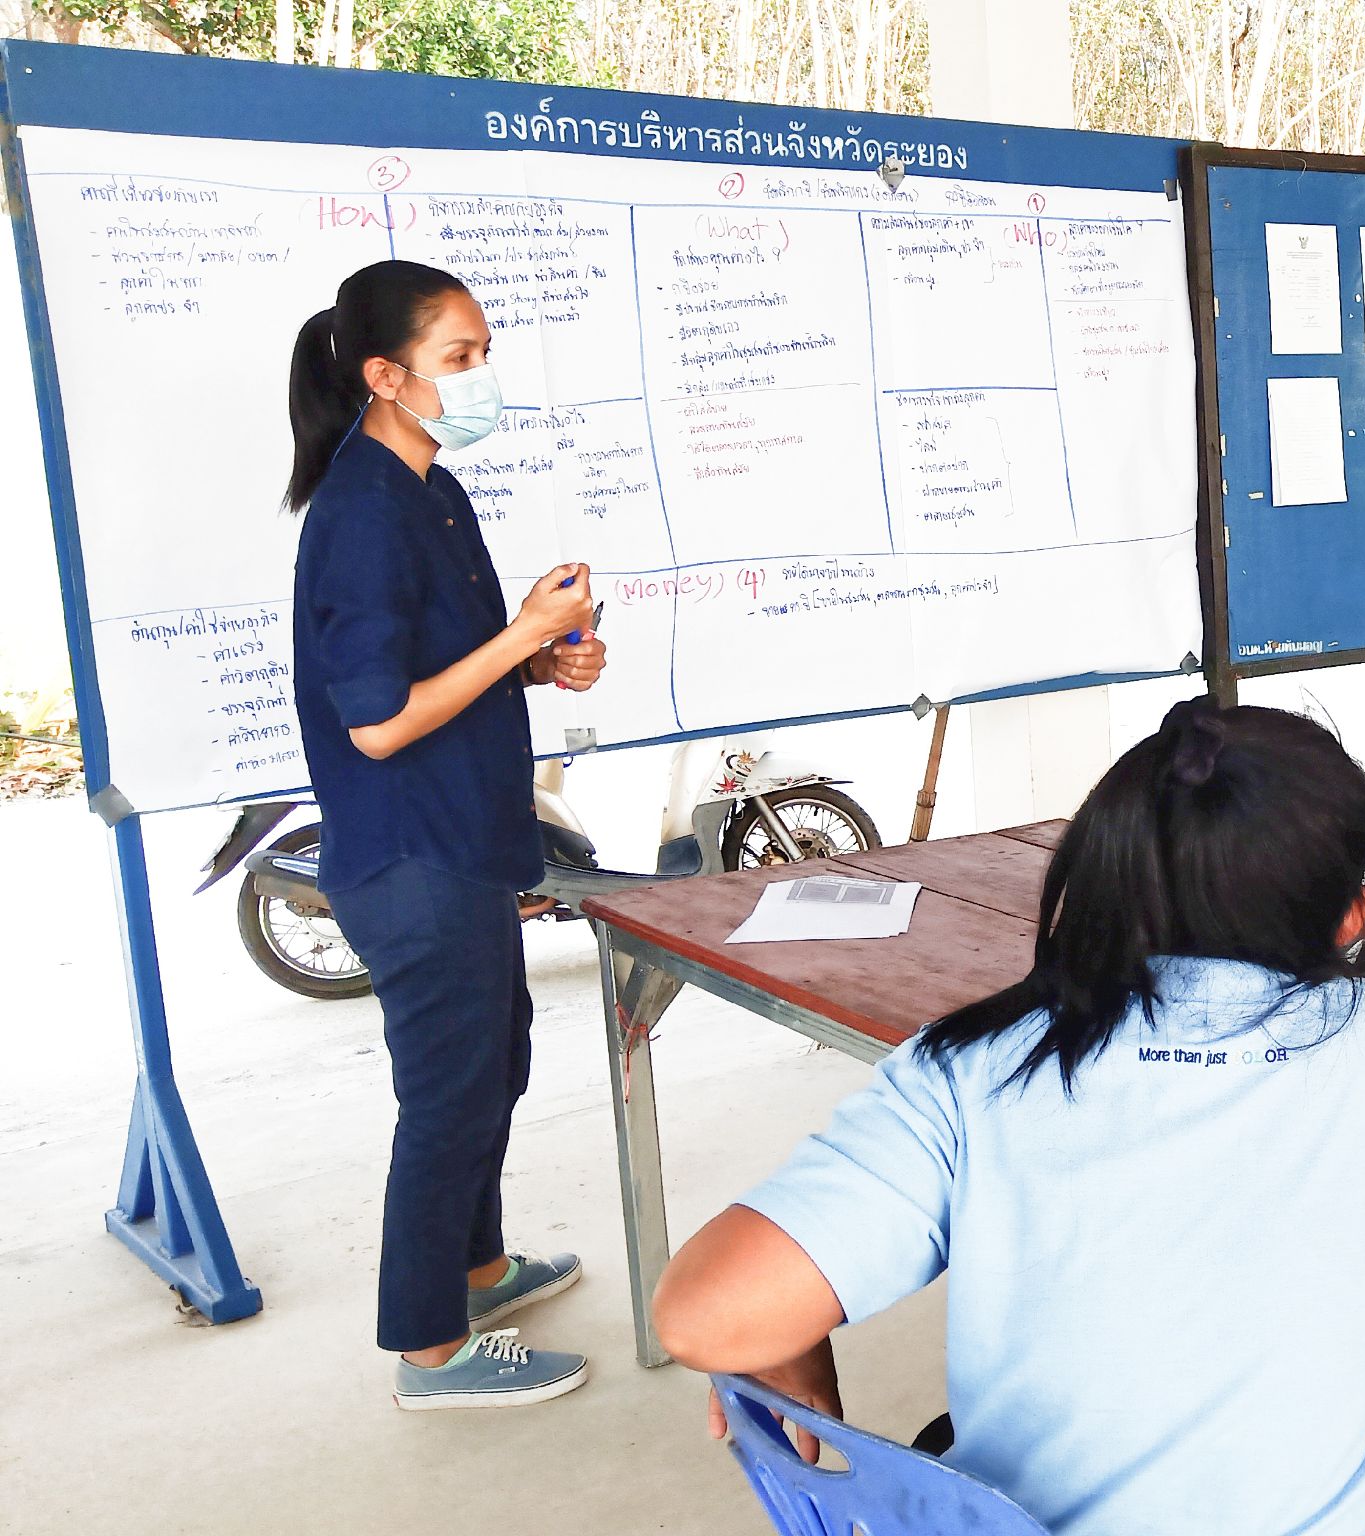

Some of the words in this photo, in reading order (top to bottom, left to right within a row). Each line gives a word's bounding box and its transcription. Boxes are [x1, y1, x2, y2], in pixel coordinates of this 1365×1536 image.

[486, 97, 967, 169] องค์การบริหารส่วนจังหวัดระยอง
[614, 571, 725, 606] (Money)
[1139, 1048, 1170, 1061] More
[1174, 1049, 1202, 1063] than
[1205, 1050, 1227, 1067] just
